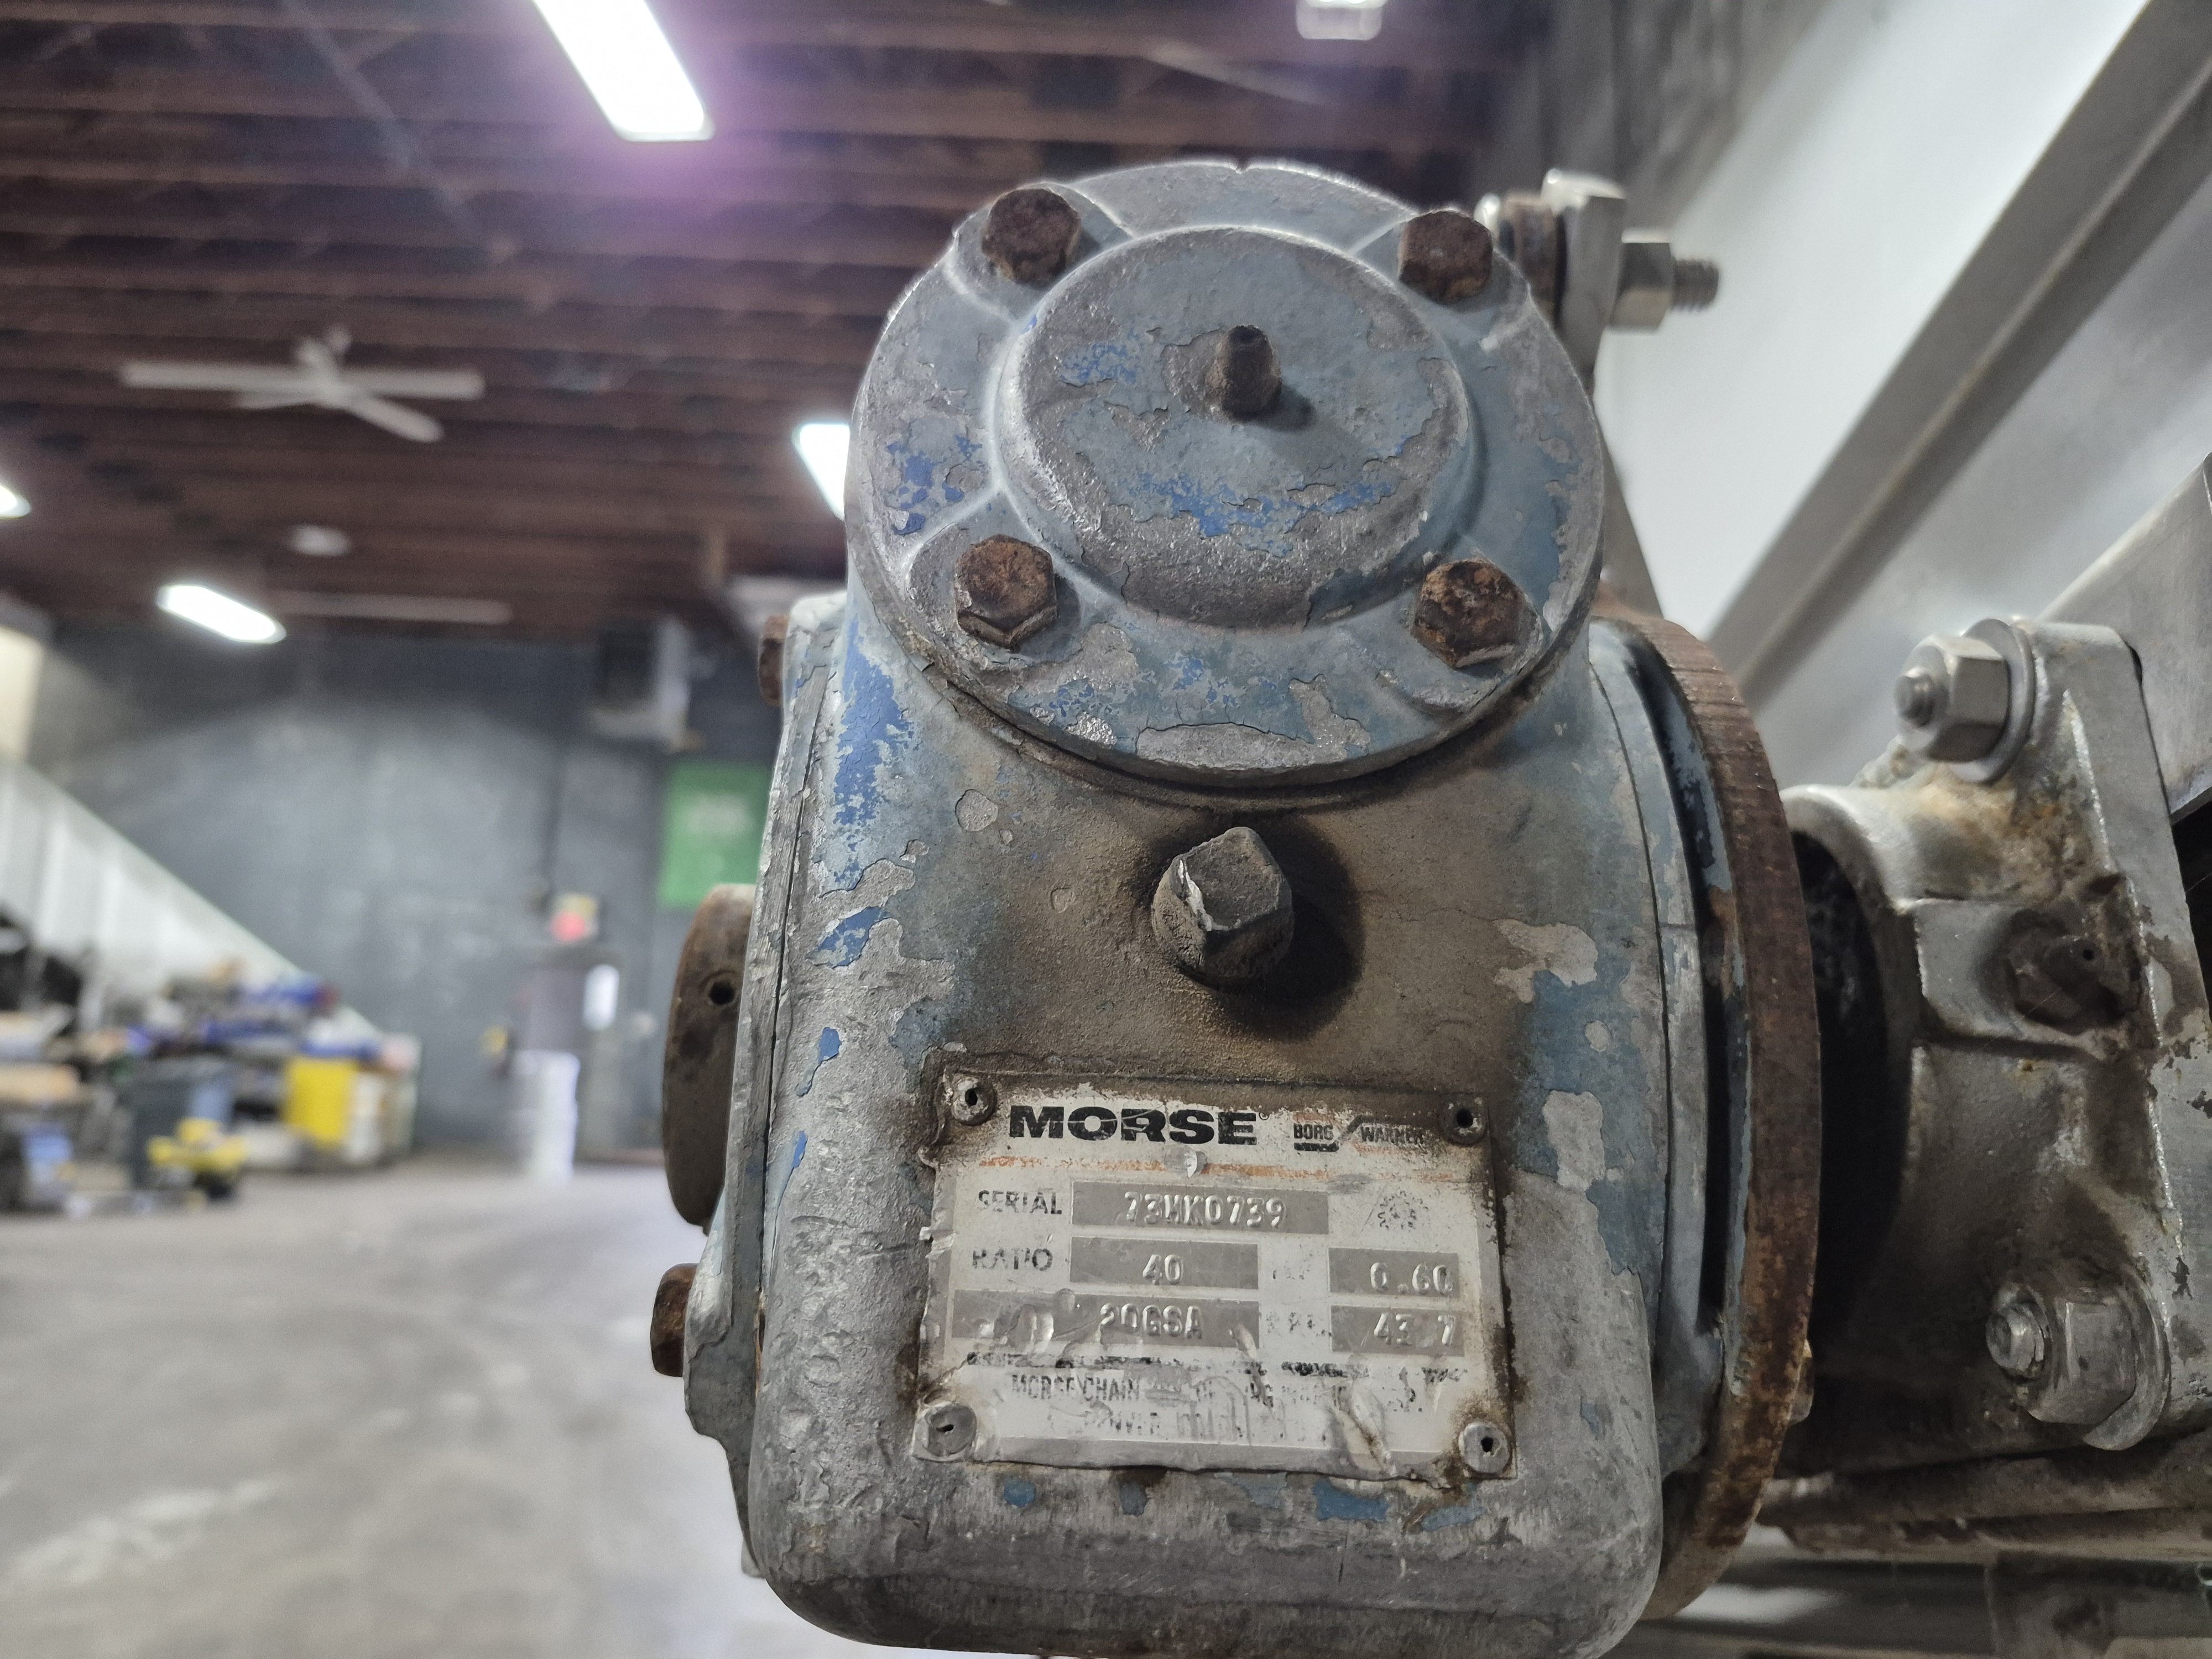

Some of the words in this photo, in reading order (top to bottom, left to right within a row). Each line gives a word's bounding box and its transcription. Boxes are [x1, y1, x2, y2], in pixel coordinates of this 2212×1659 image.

[1009, 1105, 1258, 1145] MORSE
[1293, 1124, 1334, 1140] BORG
[978, 1190, 1062, 1214] SERIAL
[972, 1247, 1053, 1271] RATIO
[1142, 1254, 1183, 1286] 40
[1370, 1261, 1453, 1296] 0.60
